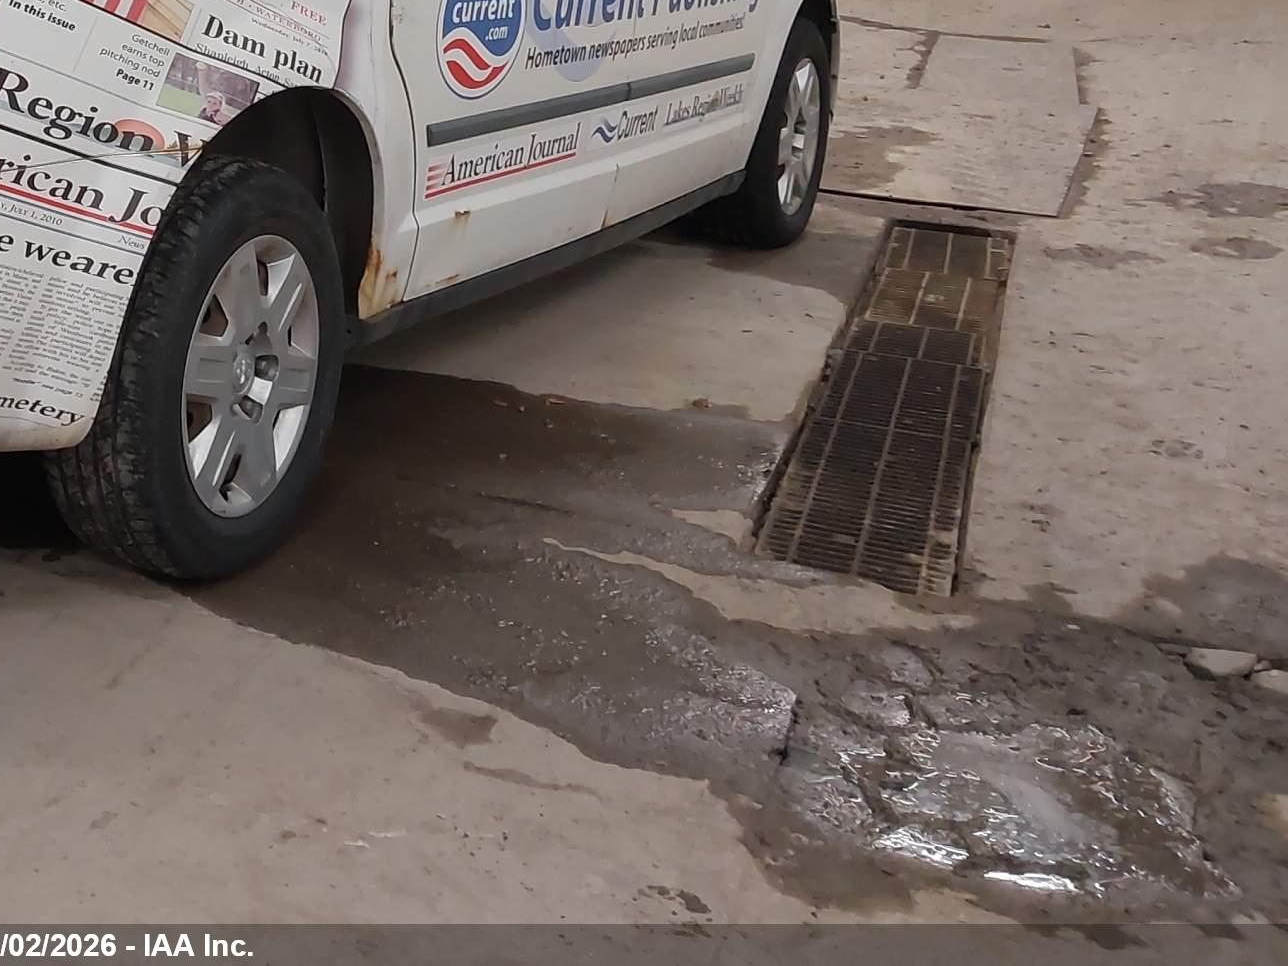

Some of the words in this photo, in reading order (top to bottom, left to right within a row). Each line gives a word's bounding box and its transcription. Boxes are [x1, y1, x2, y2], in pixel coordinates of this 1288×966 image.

[23, 3, 47, 19] this
[47, 12, 76, 31] issue
[290, 1, 328, 26] FREE
[131, 34, 170, 56] Getchell
[485, 26, 509, 41] .com
[525, 46, 587, 70] Hometown
[588, 34, 646, 61] newspapers
[647, 25, 678, 50] serving
[678, 20, 700, 44] local
[122, 44, 147, 60] earns
[149, 53, 165, 68] top
[201, 13, 266, 58] Dam
[273, 48, 323, 84] plan
[99, 47, 140, 71] pitching
[141, 65, 160, 78] nod
[116, 68, 141, 85] Page
[144, 80, 154, 91] 11
[616, 105, 659, 141] Current
[663, 99, 691, 126] Lakes
[441, 144, 524, 186] American
[524, 122, 581, 169] Journal
[8, 203, 29, 217] JULY
[40, 213, 63, 226] 2010
[117, 234, 145, 250] News
